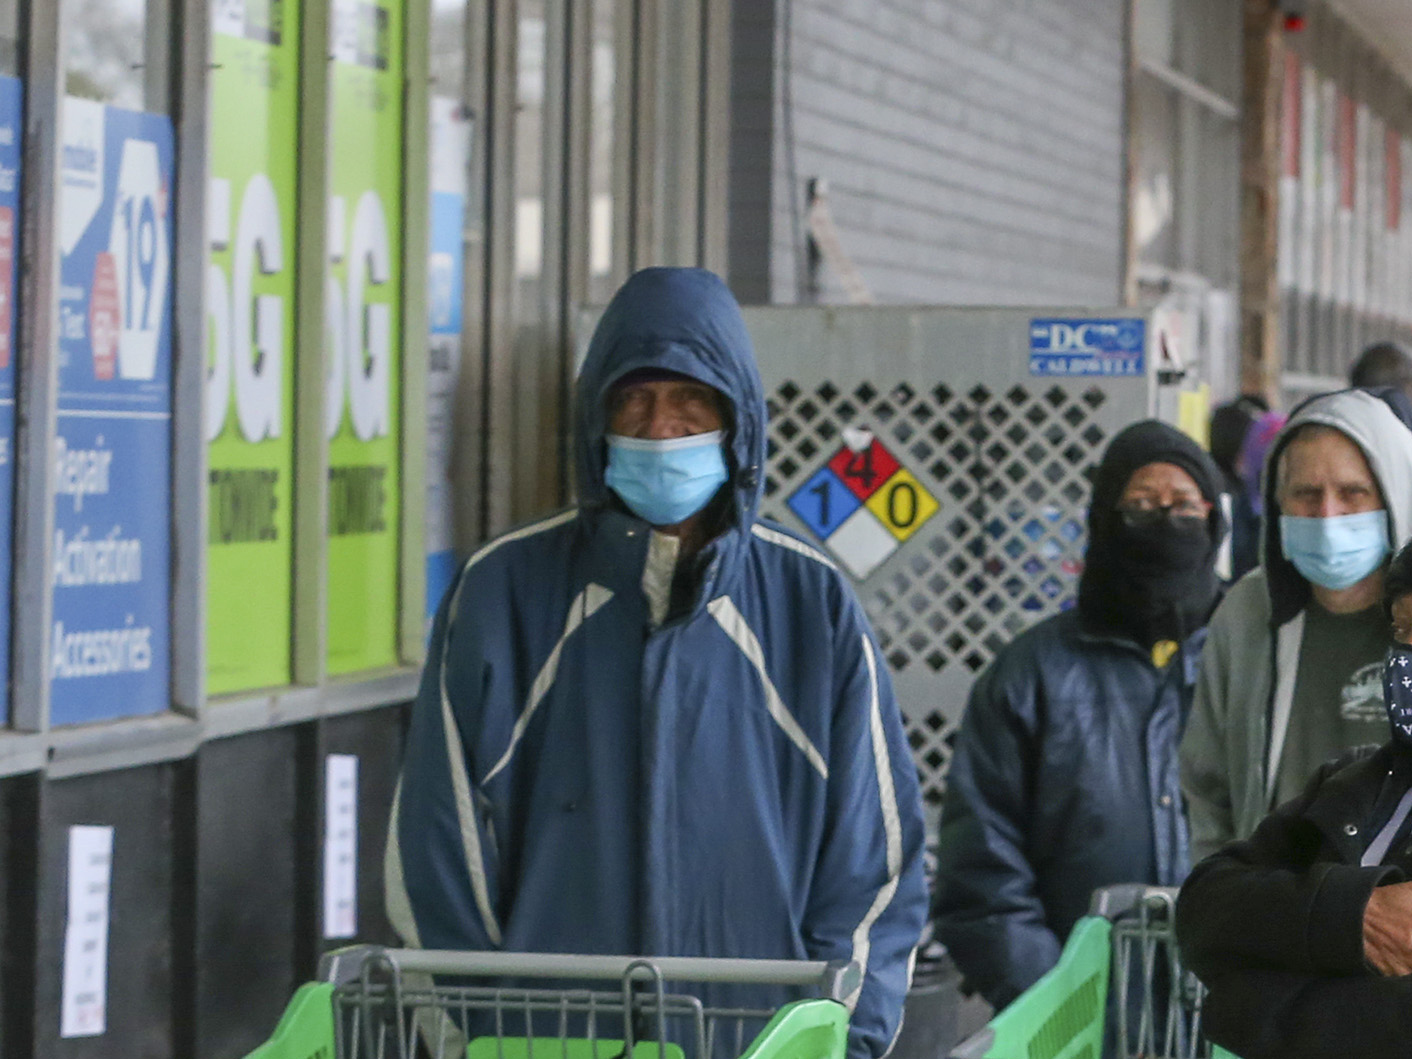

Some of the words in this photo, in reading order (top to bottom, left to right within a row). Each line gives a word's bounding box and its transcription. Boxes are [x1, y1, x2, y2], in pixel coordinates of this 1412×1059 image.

[1050, 323, 1096, 352] DC
[53, 434, 113, 513] Repair
[844, 442, 878, 488] 4
[810, 480, 831, 527] 1
[887, 481, 917, 529] 0
[53, 523, 142, 587] Activation
[50, 612, 152, 680] Accessories
